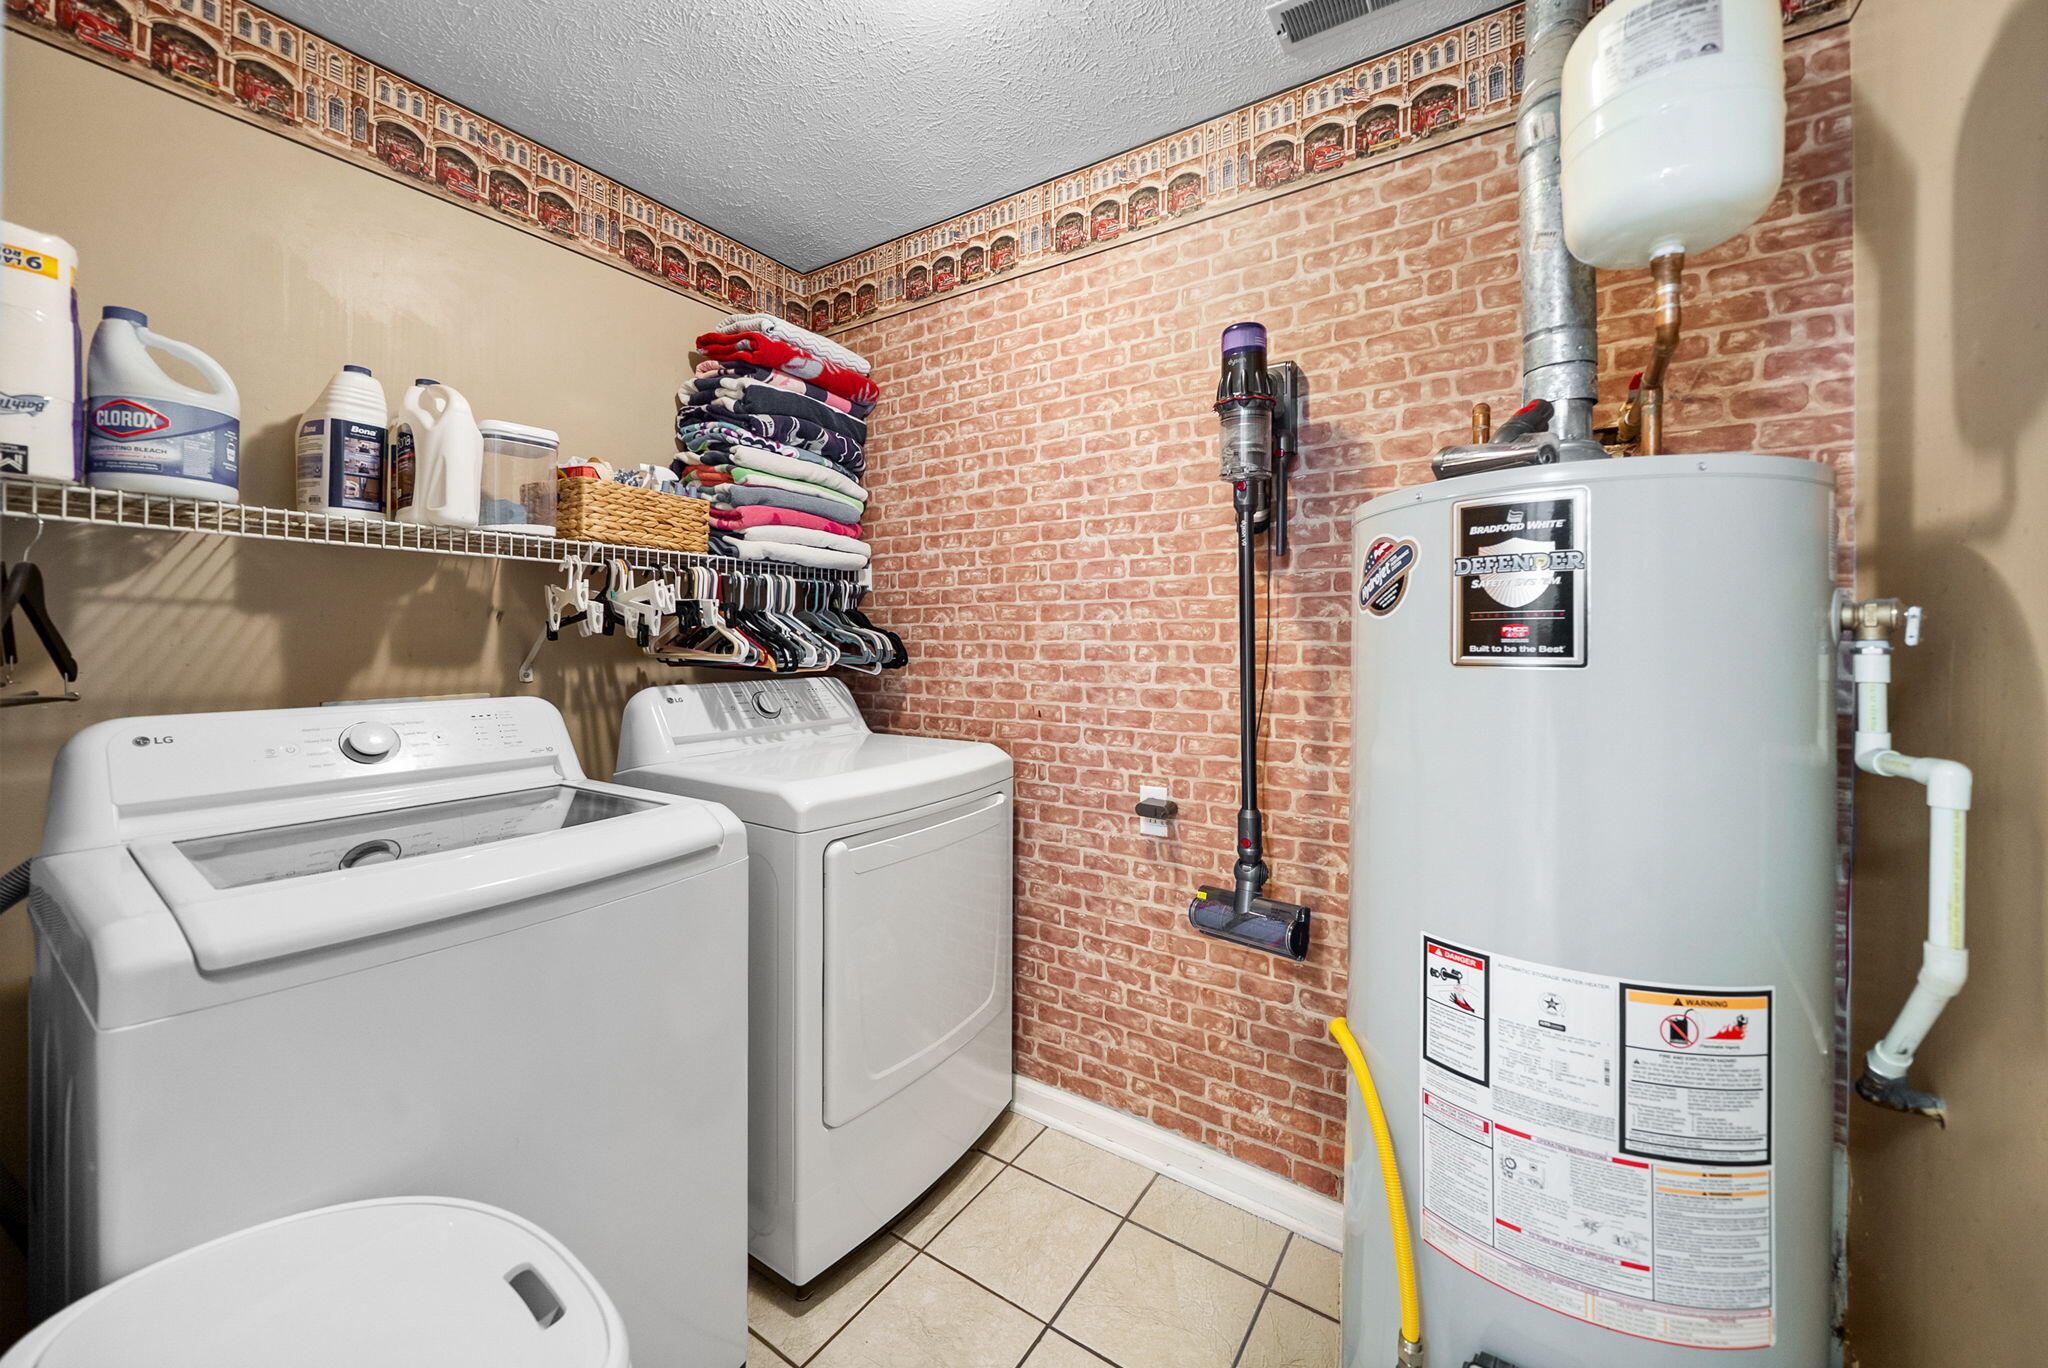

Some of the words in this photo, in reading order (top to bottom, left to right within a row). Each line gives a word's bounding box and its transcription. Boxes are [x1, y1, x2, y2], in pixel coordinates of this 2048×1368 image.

[96, 409, 158, 429] CLOROX
[350, 425, 377, 437] Bona
[133, 445, 168, 454] BLEACH
[1469, 522, 1526, 536] BRADFORD
[1526, 519, 1567, 530] WHITE
[1455, 550, 1585, 577] DEFENDER
[1469, 645, 1490, 653] Built
[1503, 645, 1518, 653] be
[1519, 645, 1537, 653] the
[1538, 645, 1564, 653] Best
[154, 735, 174, 745] LG
[1444, 951, 1477, 967] DANGER
[1685, 1000, 1729, 1008] WARNING
